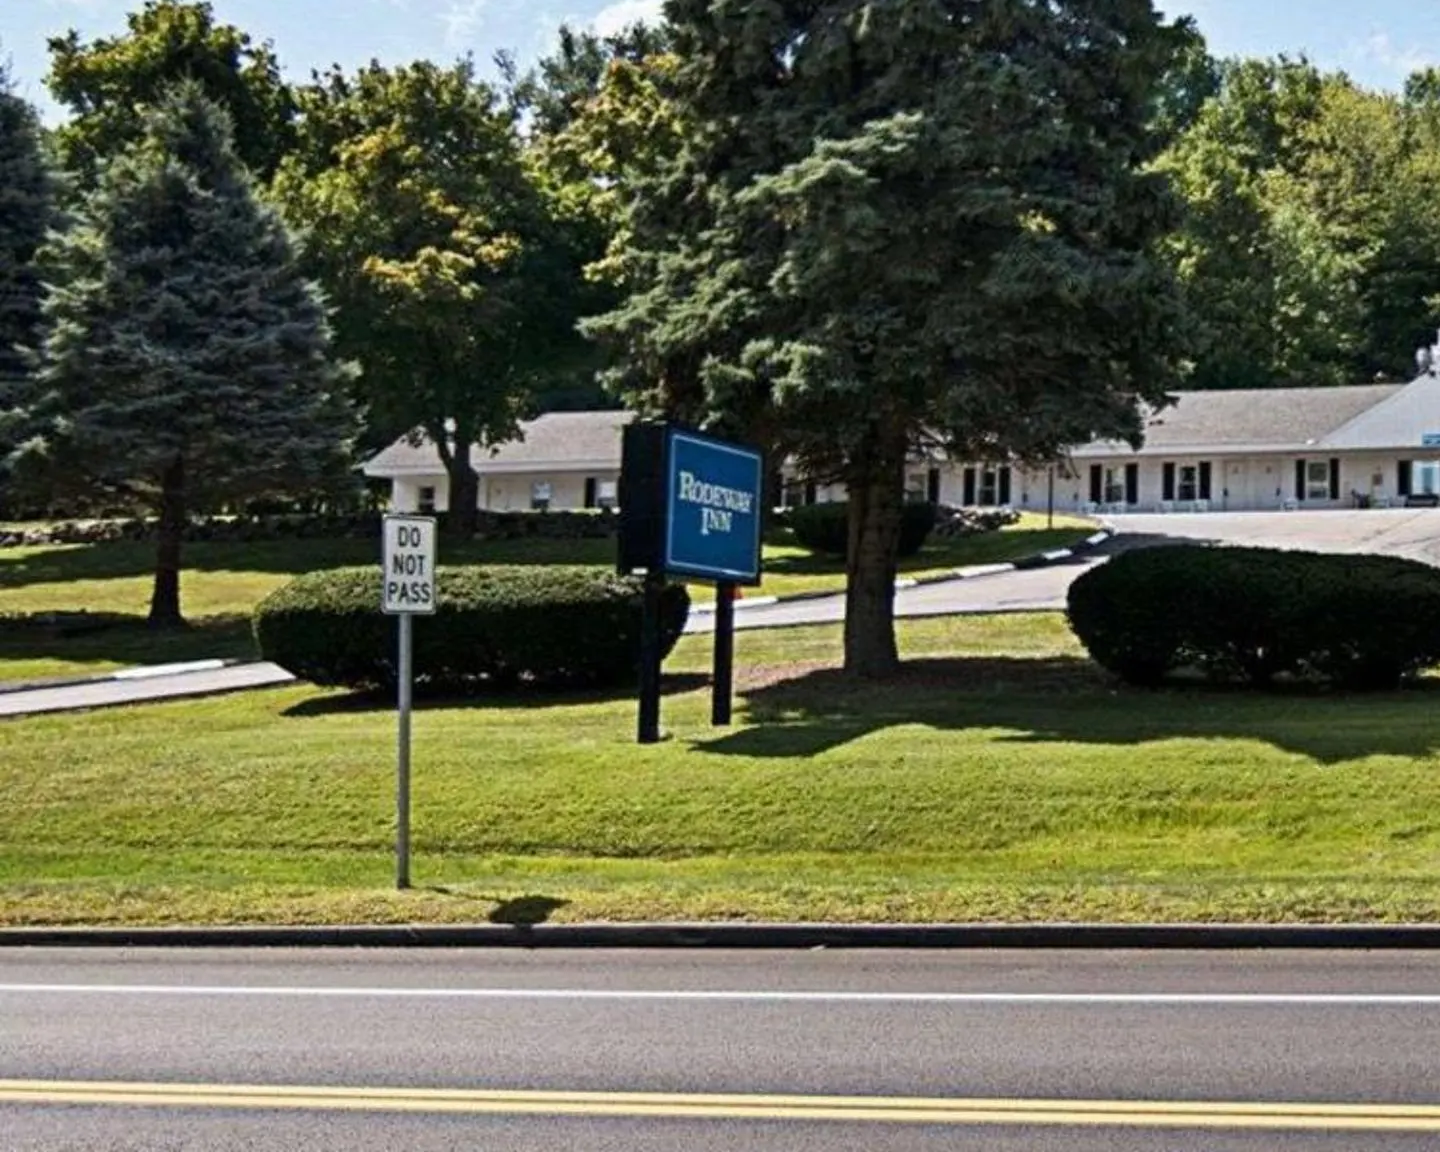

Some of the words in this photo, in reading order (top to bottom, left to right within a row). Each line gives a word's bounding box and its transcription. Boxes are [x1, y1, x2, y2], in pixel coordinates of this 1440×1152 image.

[679, 470, 753, 514] RODEWAY
[701, 507, 733, 536] INN
[397, 526, 421, 547] DO
[393, 554, 426, 576] NOT
[387, 581, 431, 603] PASS
